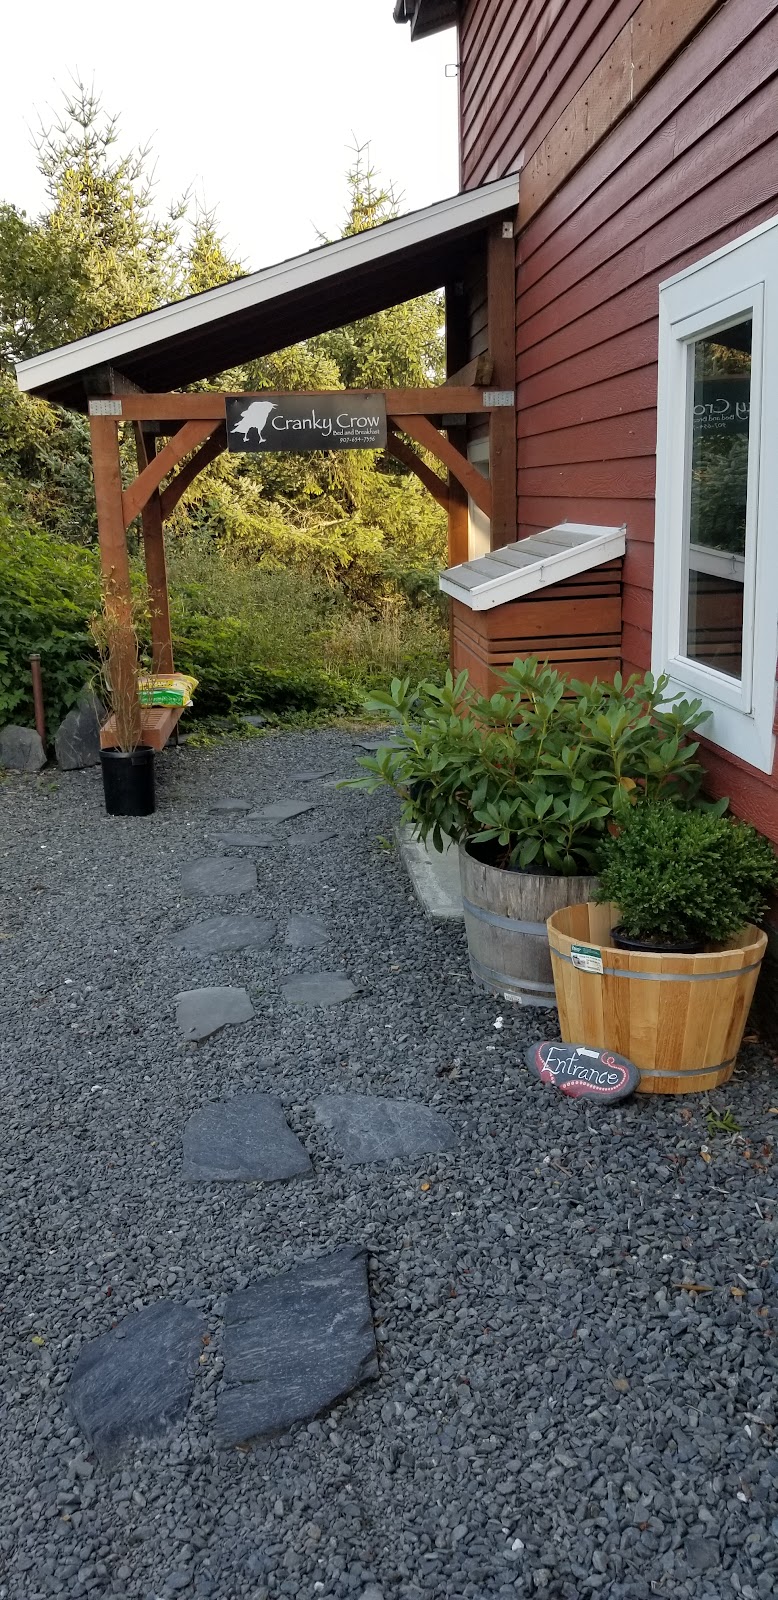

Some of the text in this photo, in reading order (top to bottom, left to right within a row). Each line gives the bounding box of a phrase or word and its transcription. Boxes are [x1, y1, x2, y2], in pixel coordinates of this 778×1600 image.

[271, 409, 380, 437] Cranky Crow
[541, 1046, 619, 1085] Entrance
